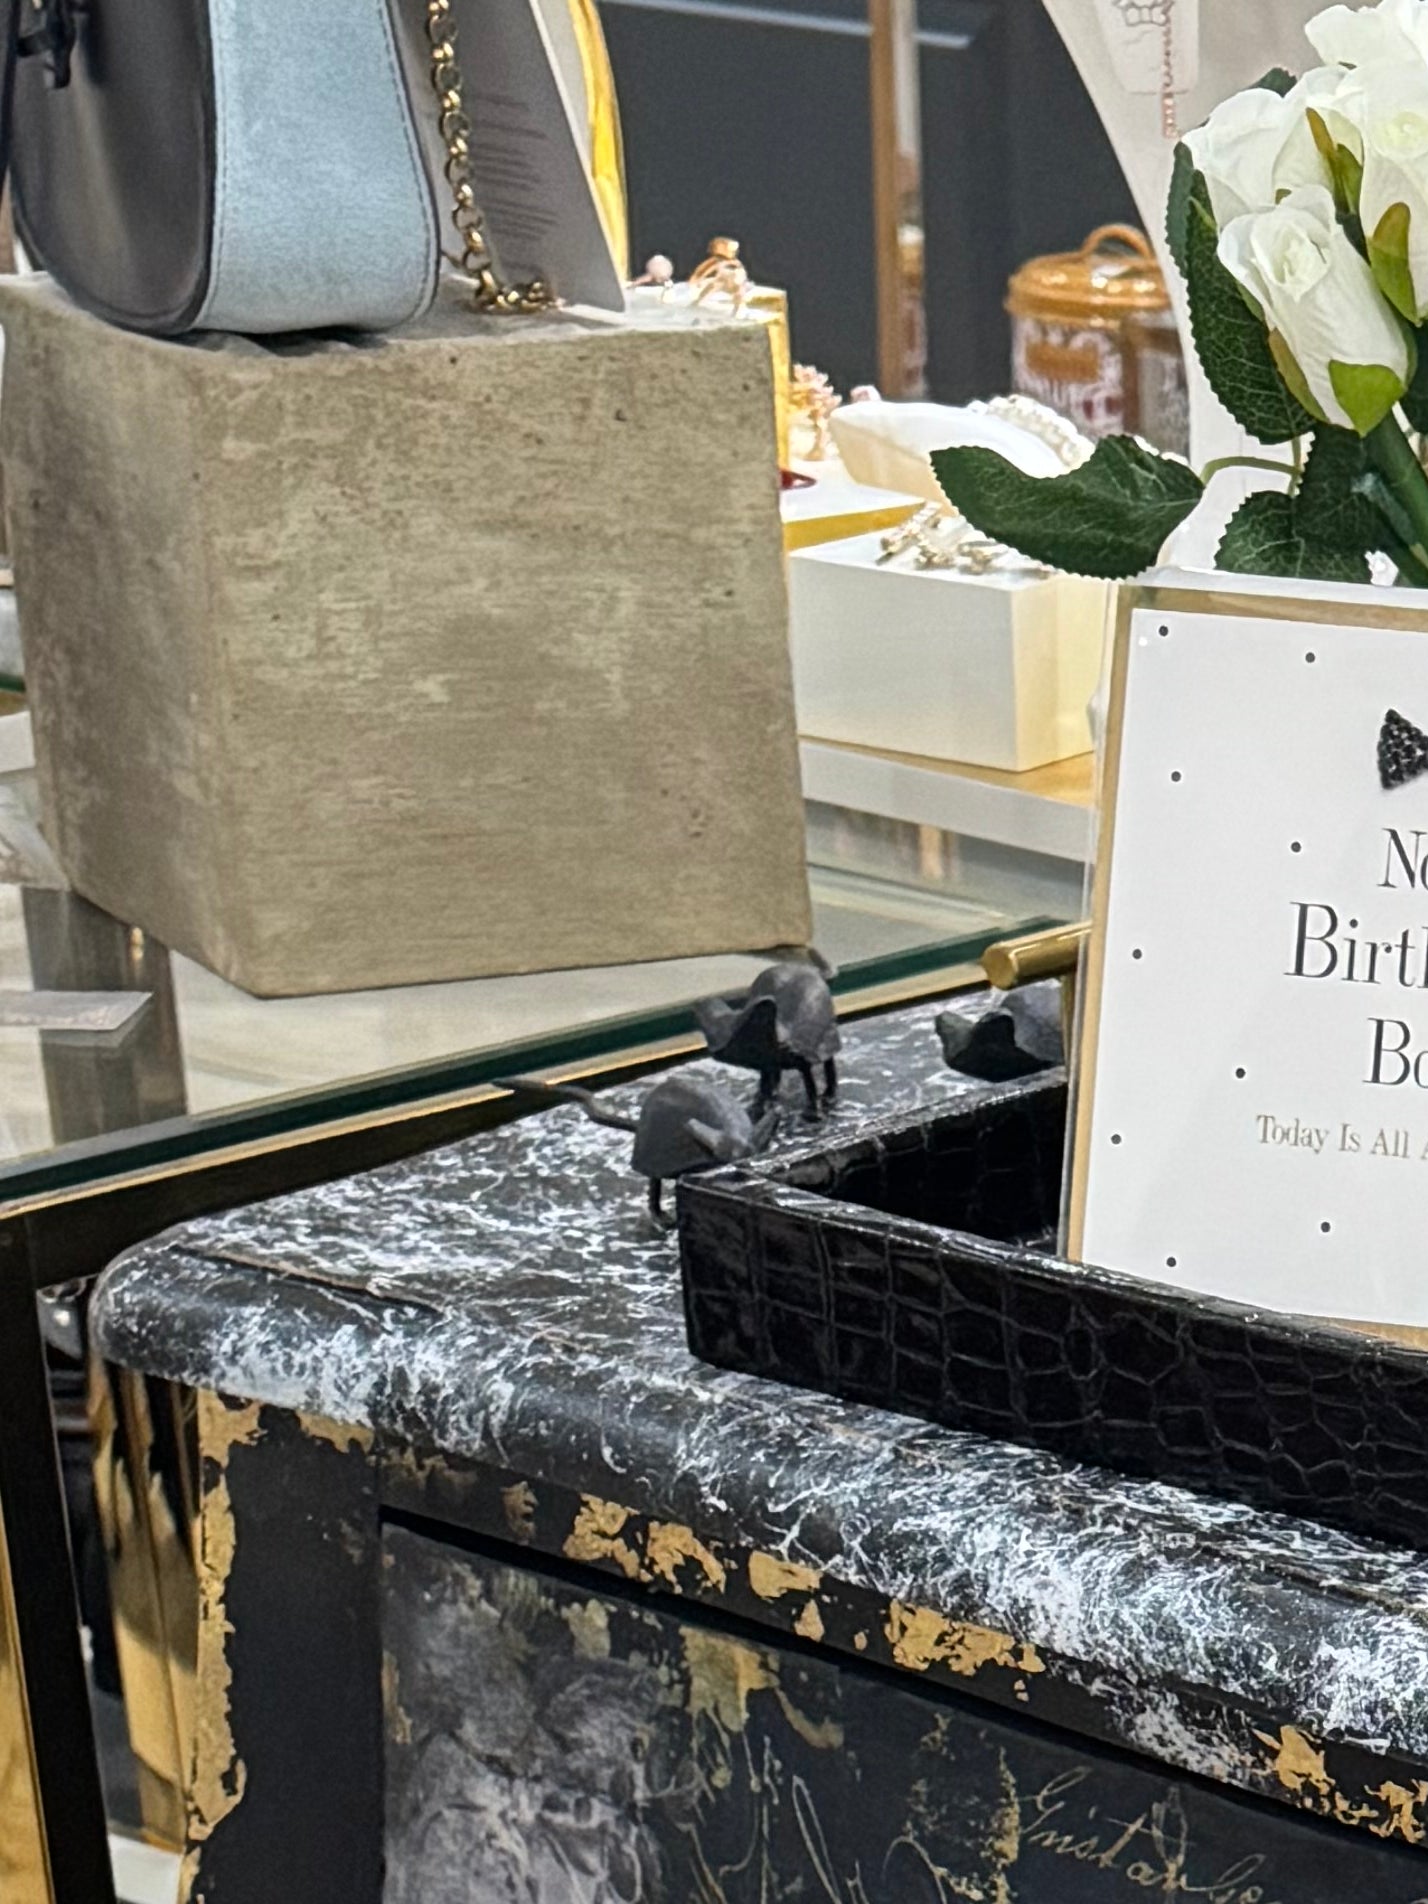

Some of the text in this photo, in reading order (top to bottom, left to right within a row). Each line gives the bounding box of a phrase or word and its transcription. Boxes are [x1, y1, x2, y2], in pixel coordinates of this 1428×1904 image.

[1257, 1114, 1330, 1154] Today
[1340, 1121, 1362, 1153] Is
[1370, 1127, 1411, 1160] All
